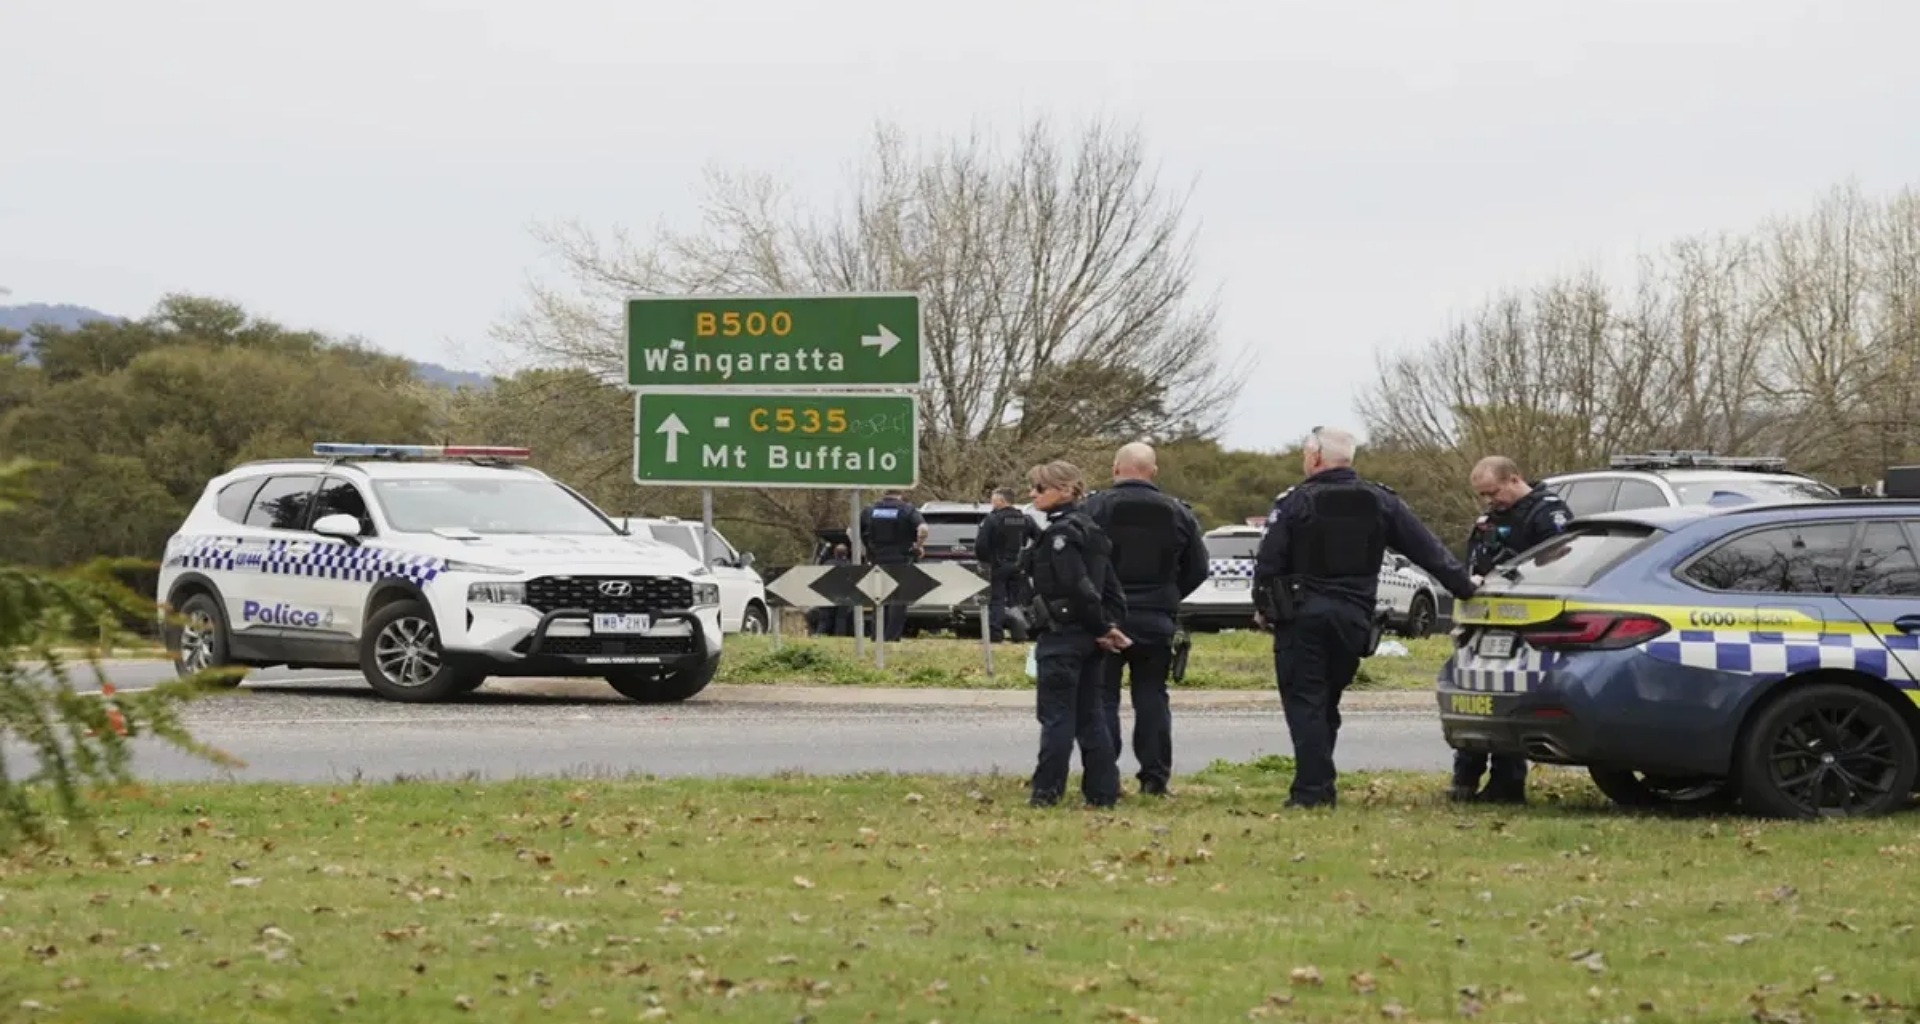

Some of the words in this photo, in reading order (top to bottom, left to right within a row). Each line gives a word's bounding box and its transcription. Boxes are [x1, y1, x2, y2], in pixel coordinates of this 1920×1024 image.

[697, 311, 793, 337] B500
[644, 348, 844, 380] Wangaratta
[750, 408, 848, 433] C535
[702, 444, 747, 469] Mt
[768, 445, 897, 472] Buffalo
[243, 600, 320, 627] Police
[1451, 694, 1494, 716] POLICE
